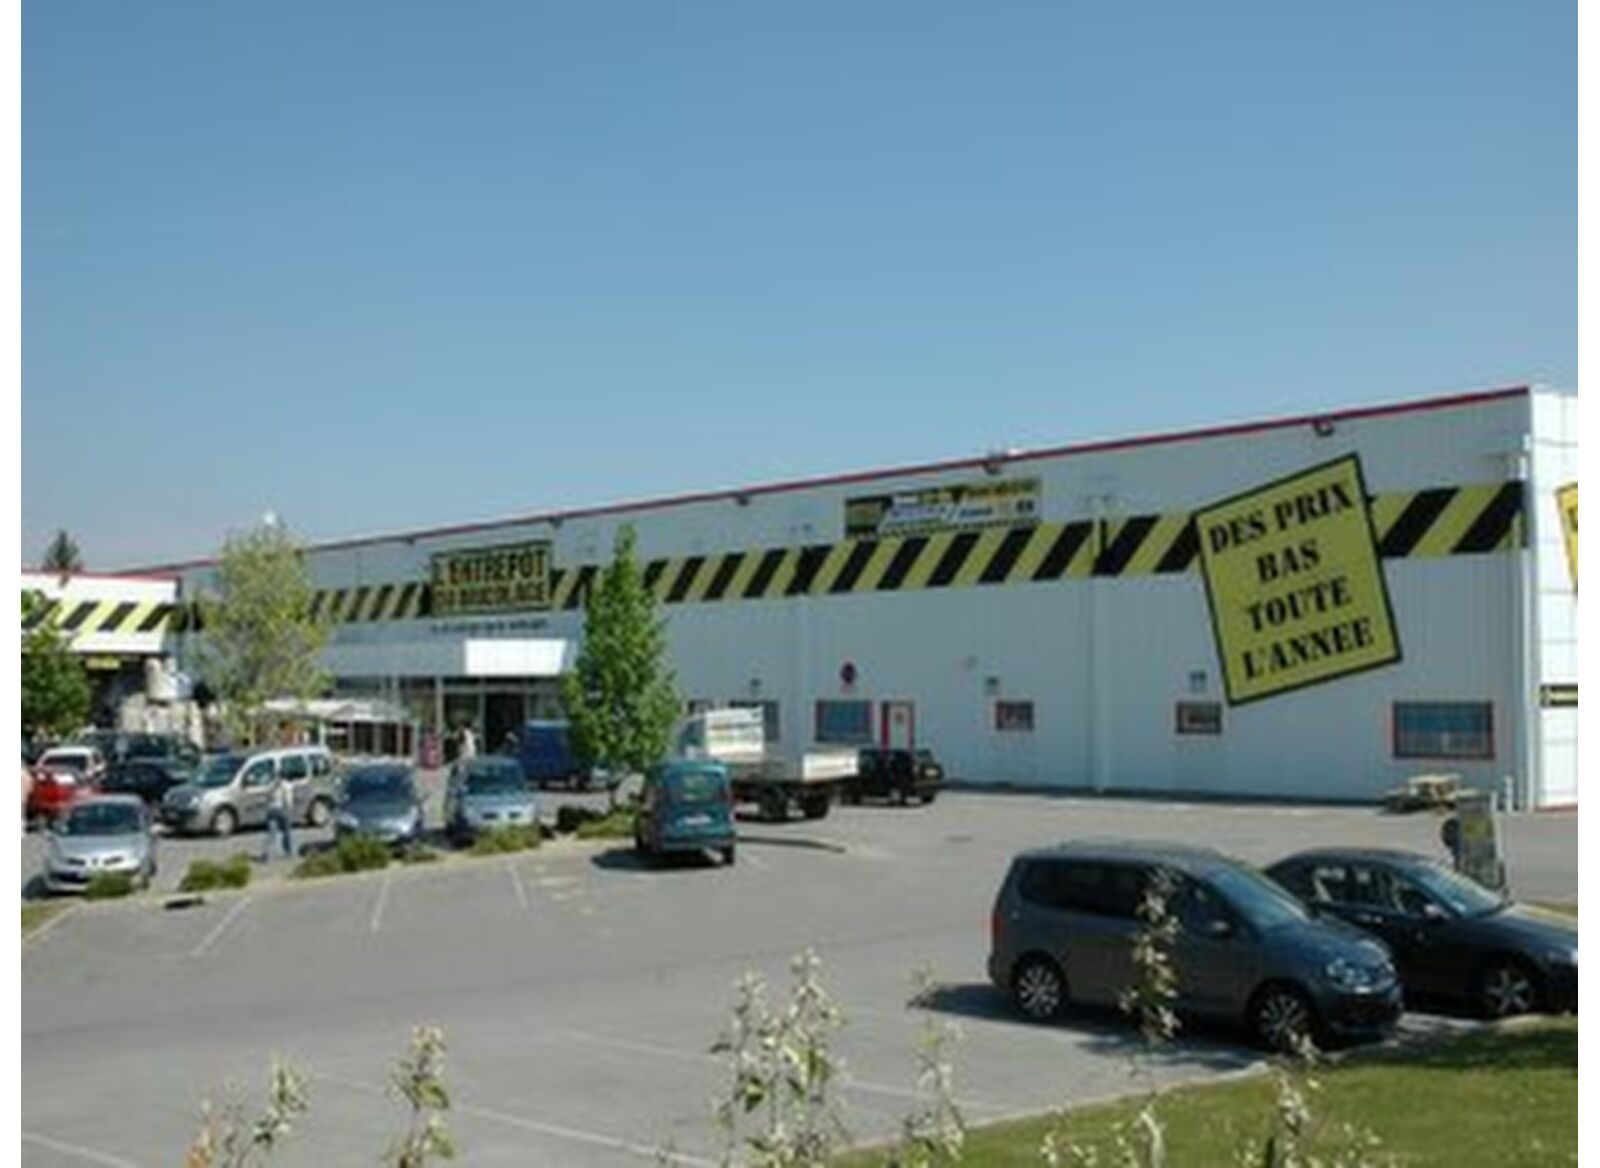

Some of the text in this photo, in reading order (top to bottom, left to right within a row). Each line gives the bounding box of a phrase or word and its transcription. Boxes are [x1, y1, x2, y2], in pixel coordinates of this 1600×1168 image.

[1208, 482, 1353, 554] DES PRIX
[1256, 537, 1321, 583] BAS
[1246, 575, 1352, 633] TOUTE
